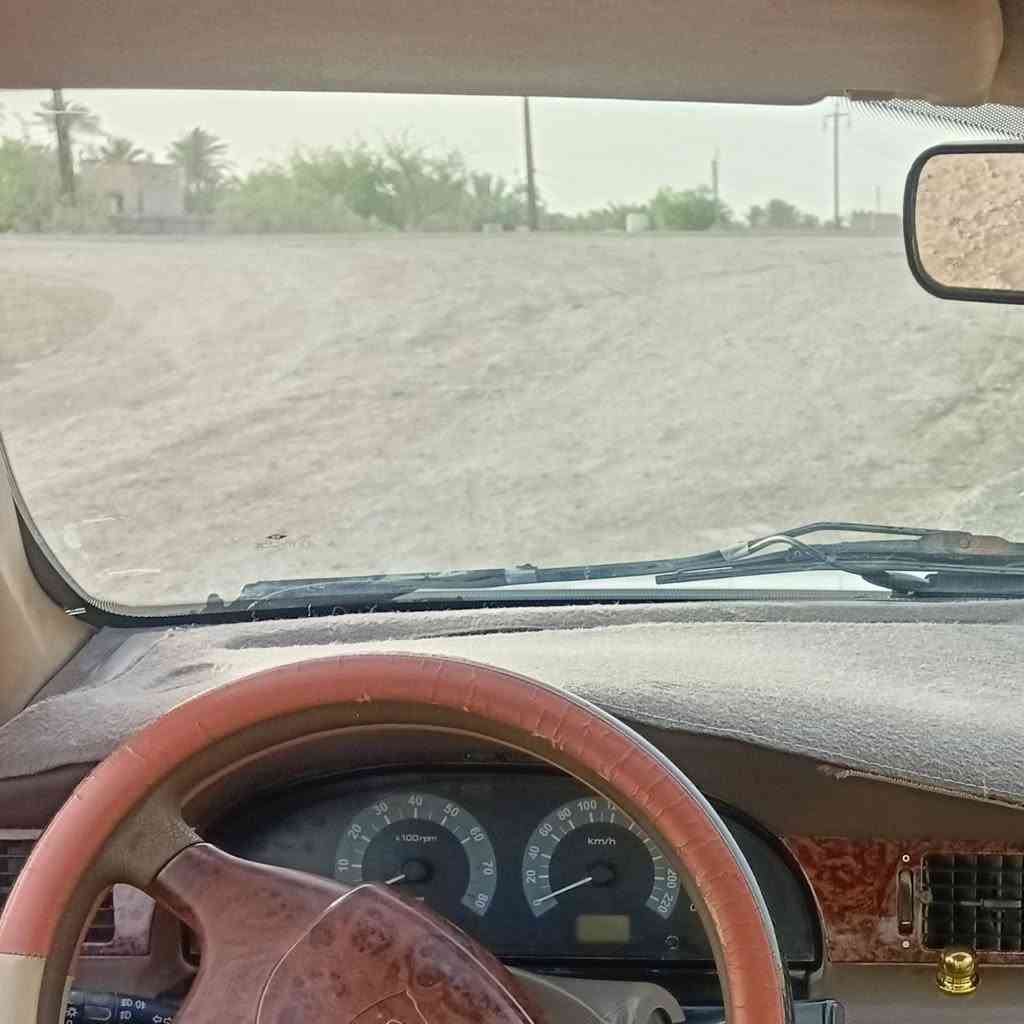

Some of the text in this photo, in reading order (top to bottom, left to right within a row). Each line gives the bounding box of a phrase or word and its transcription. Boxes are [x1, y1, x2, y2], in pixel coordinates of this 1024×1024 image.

[443, 804, 459, 817] 50
[577, 800, 597, 811] 100
[348, 824, 362, 840] 20
[469, 826, 484, 842] 60
[528, 846, 540, 860] 40
[337, 858, 349, 871] 10
[482, 861, 494, 876] 70
[526, 870, 536, 884] 20
[659, 894, 674, 913] 220
